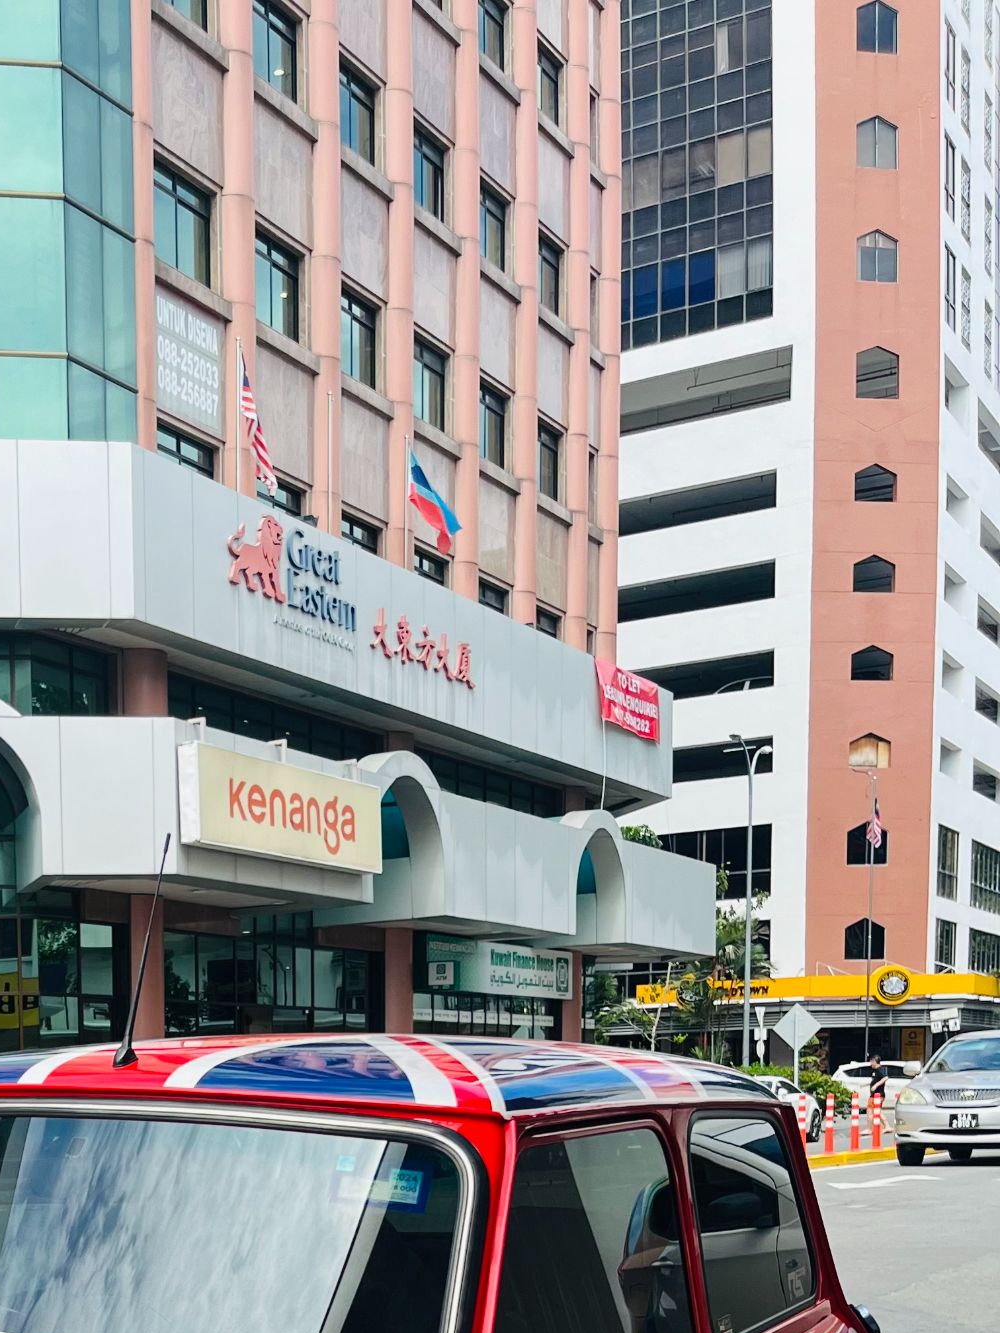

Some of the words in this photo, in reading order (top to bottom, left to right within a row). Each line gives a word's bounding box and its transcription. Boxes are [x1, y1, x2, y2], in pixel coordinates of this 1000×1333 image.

[157, 296, 187, 337] UNTUK
[187, 313, 218, 356] DISEWA
[157, 335, 219, 389] 088-252033
[157, 364, 219, 417] 088-256887
[287, 528, 341, 586] Great
[287, 567, 357, 632] Eastern
[229, 777, 356, 855] kenanga
[491, 949, 512, 968] Kuwait
[512, 952, 536, 971] Finance
[536, 955, 554, 972] House
